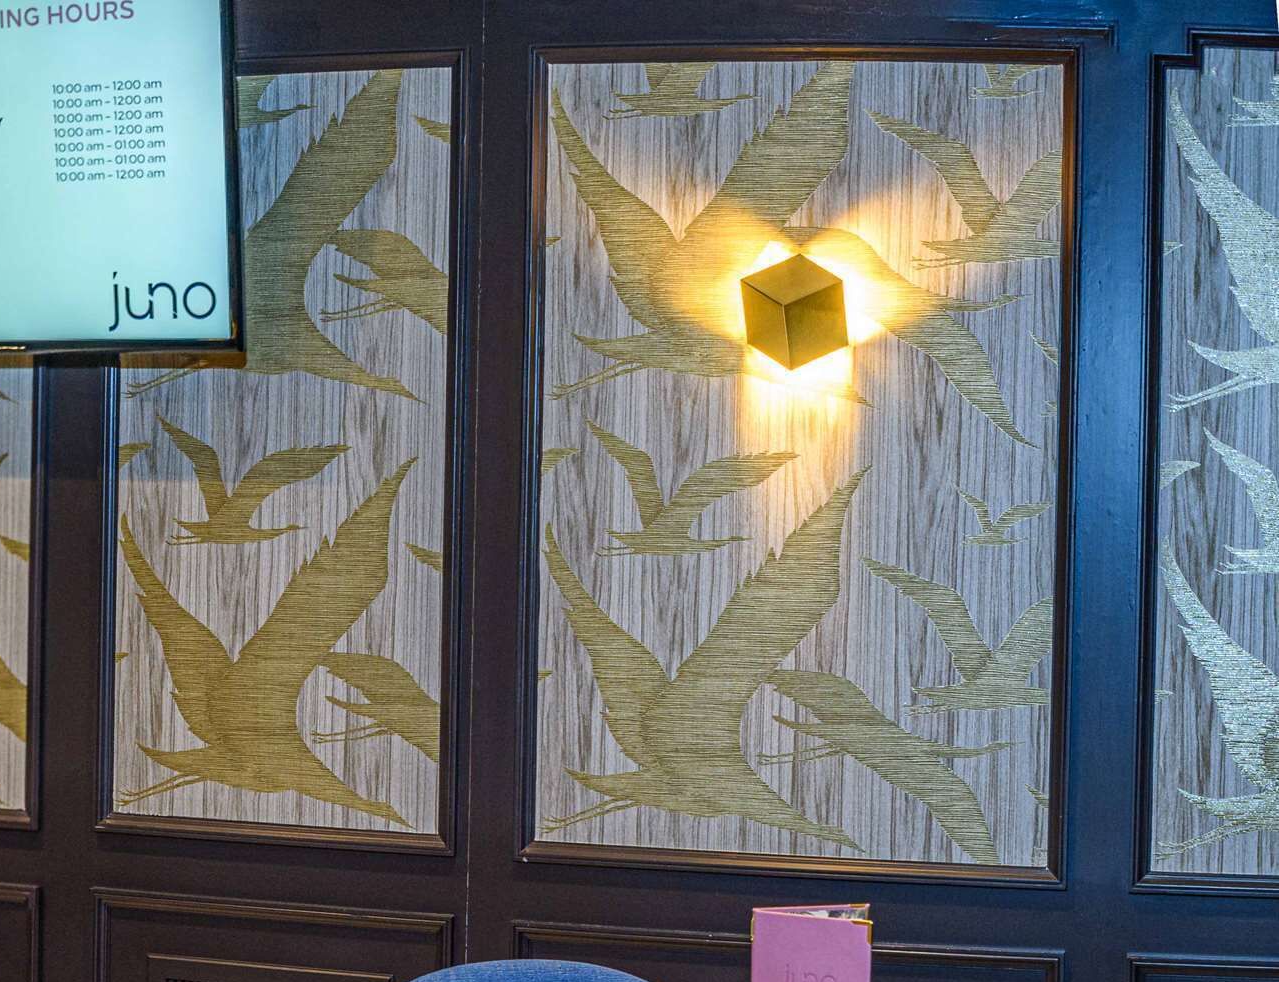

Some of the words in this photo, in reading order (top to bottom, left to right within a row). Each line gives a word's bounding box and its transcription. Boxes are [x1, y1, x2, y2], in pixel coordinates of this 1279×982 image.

[47, 0, 135, 25] HOURS
[84, 84, 102, 92] am
[143, 80, 162, 89] am
[84, 99, 103, 107] am
[144, 95, 163, 104] am
[85, 114, 103, 122] am
[144, 110, 163, 119] am
[85, 128, 103, 136] am
[145, 125, 164, 134] am
[86, 143, 104, 151] am
[147, 140, 166, 149] am
[86, 157, 105, 166] am
[147, 155, 166, 164] am
[87, 172, 106, 181] am
[146, 169, 165, 178] am
[108, 271, 218, 332] juno
